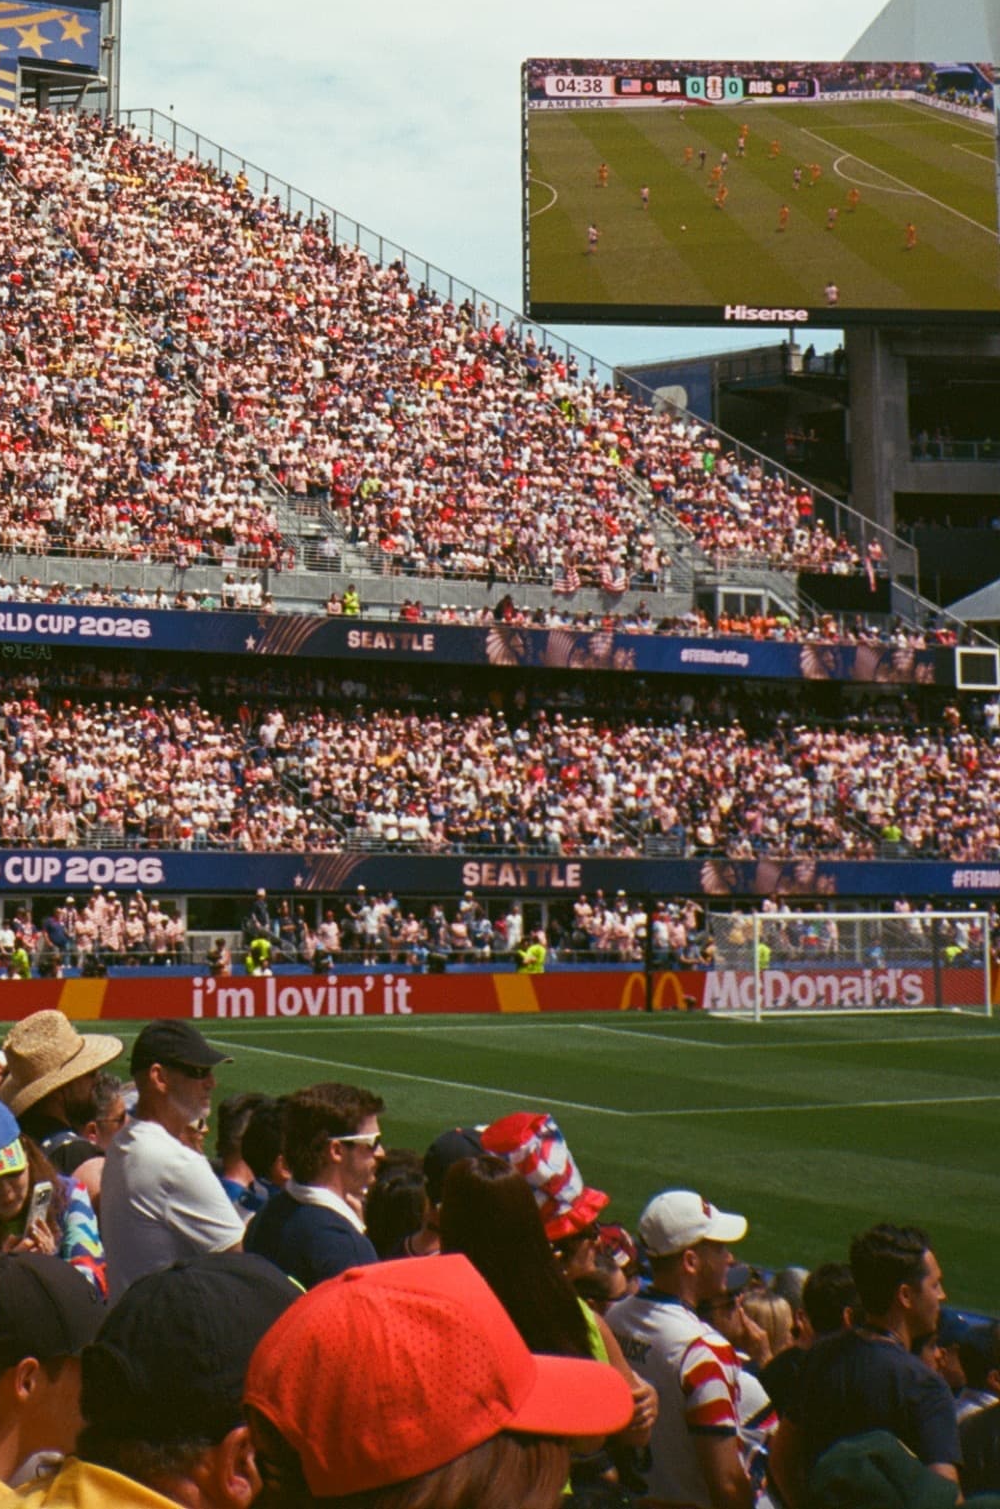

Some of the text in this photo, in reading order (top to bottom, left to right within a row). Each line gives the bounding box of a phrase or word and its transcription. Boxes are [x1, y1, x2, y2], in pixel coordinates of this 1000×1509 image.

[555, 78, 773, 94] 04:38 USA 0 0 AUS
[724, 304, 809, 322] Hisense
[35, 614, 77, 635] CUP
[79, 616, 152, 638] 2026
[347, 630, 434, 651] SEATTLE
[4, 856, 62, 883] CUP
[64, 857, 164, 884] 2026
[462, 861, 581, 887] SEATTLE
[383, 974, 413, 1015] it
